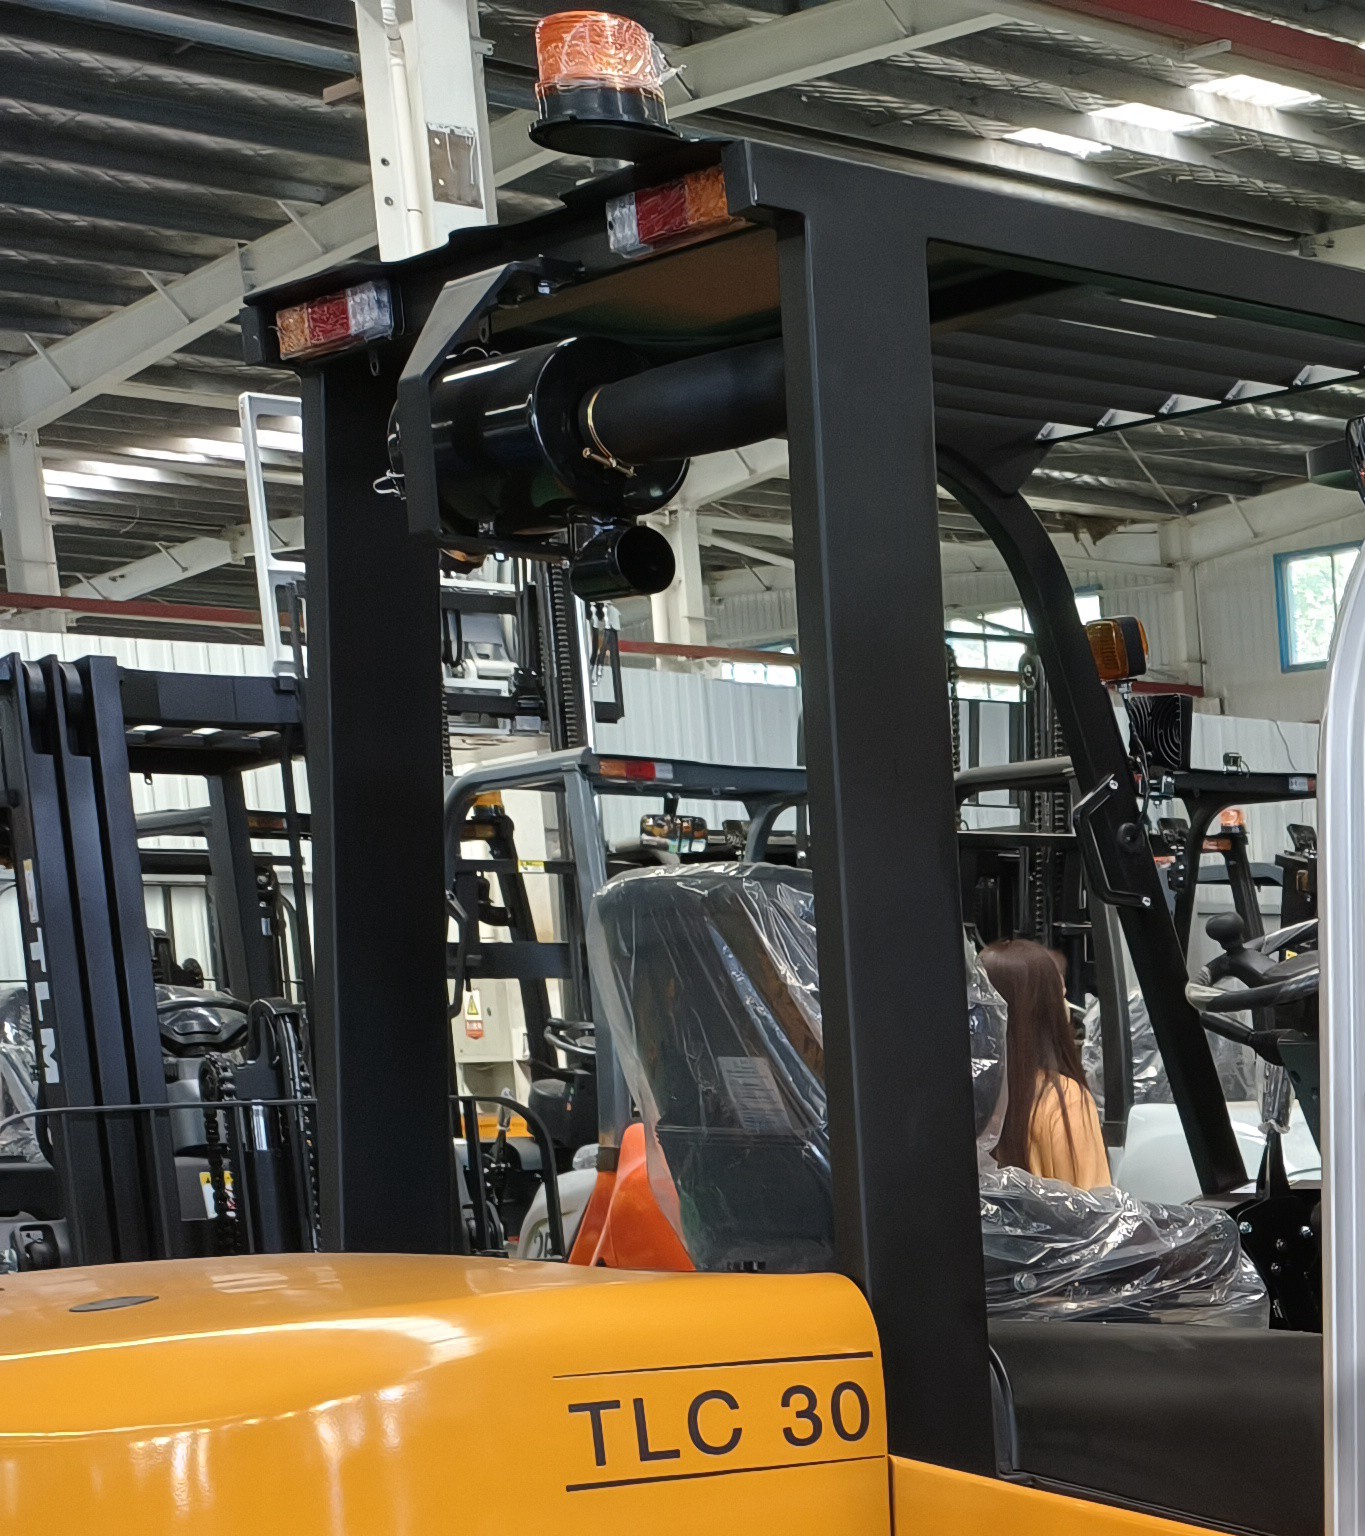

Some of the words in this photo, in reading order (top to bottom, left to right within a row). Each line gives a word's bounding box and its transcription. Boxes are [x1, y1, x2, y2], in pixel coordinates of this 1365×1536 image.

[30, 927, 60, 1083] TLM
[568, 1389, 743, 1467] TLC
[782, 1381, 871, 1447] 30
